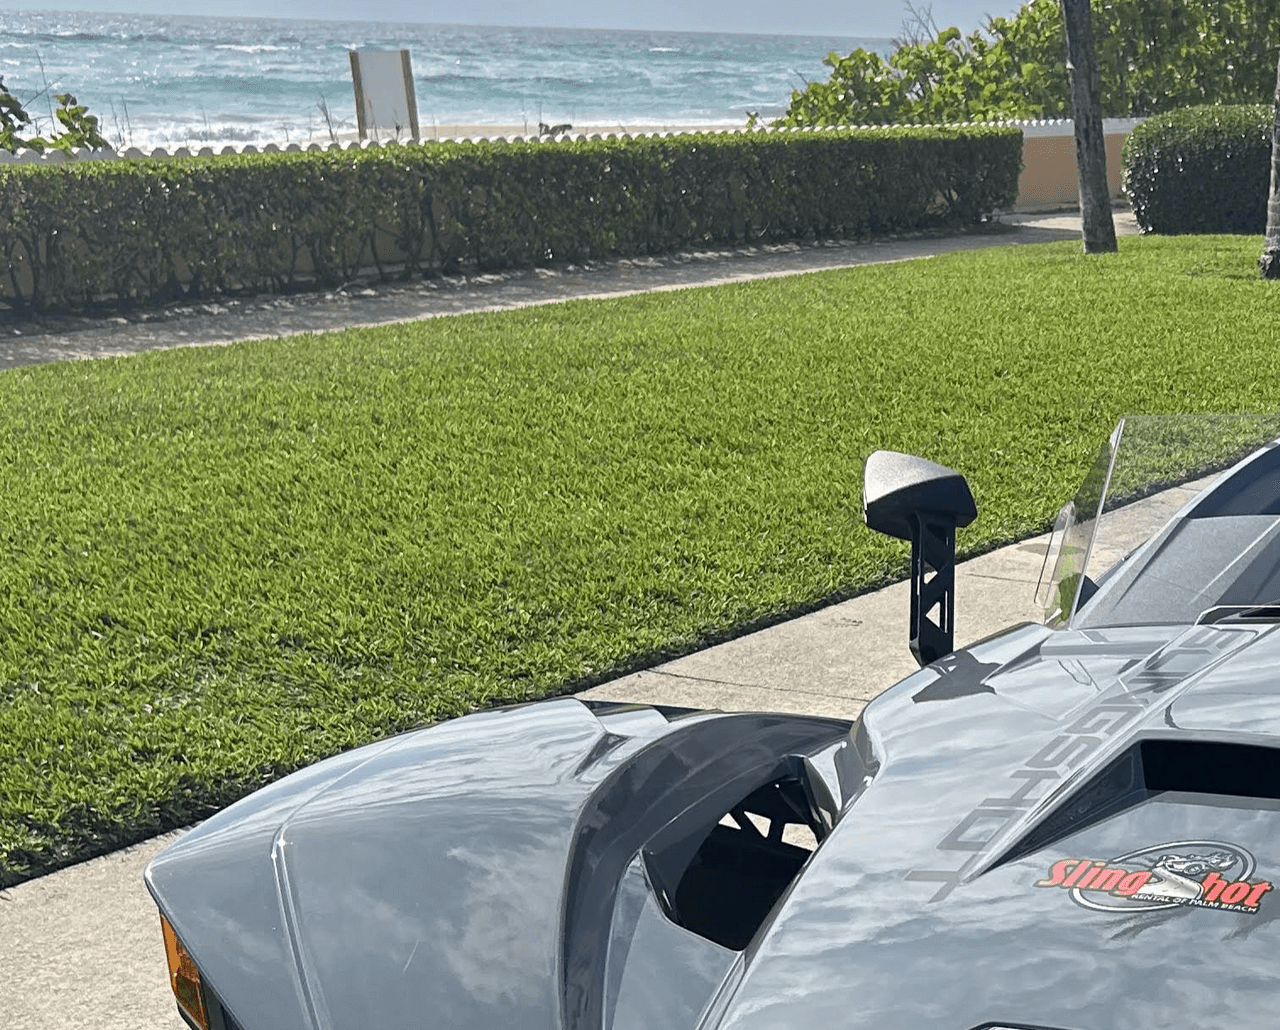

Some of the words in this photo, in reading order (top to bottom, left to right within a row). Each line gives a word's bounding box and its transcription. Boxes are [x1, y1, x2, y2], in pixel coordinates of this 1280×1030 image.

[904, 628, 1246, 903] SLINGSHOT
[1131, 893, 1171, 903] RENTAL
[1172, 896, 1188, 904] OF
[1188, 897, 1219, 908] PALM
[1220, 902, 1258, 913] BEACH
